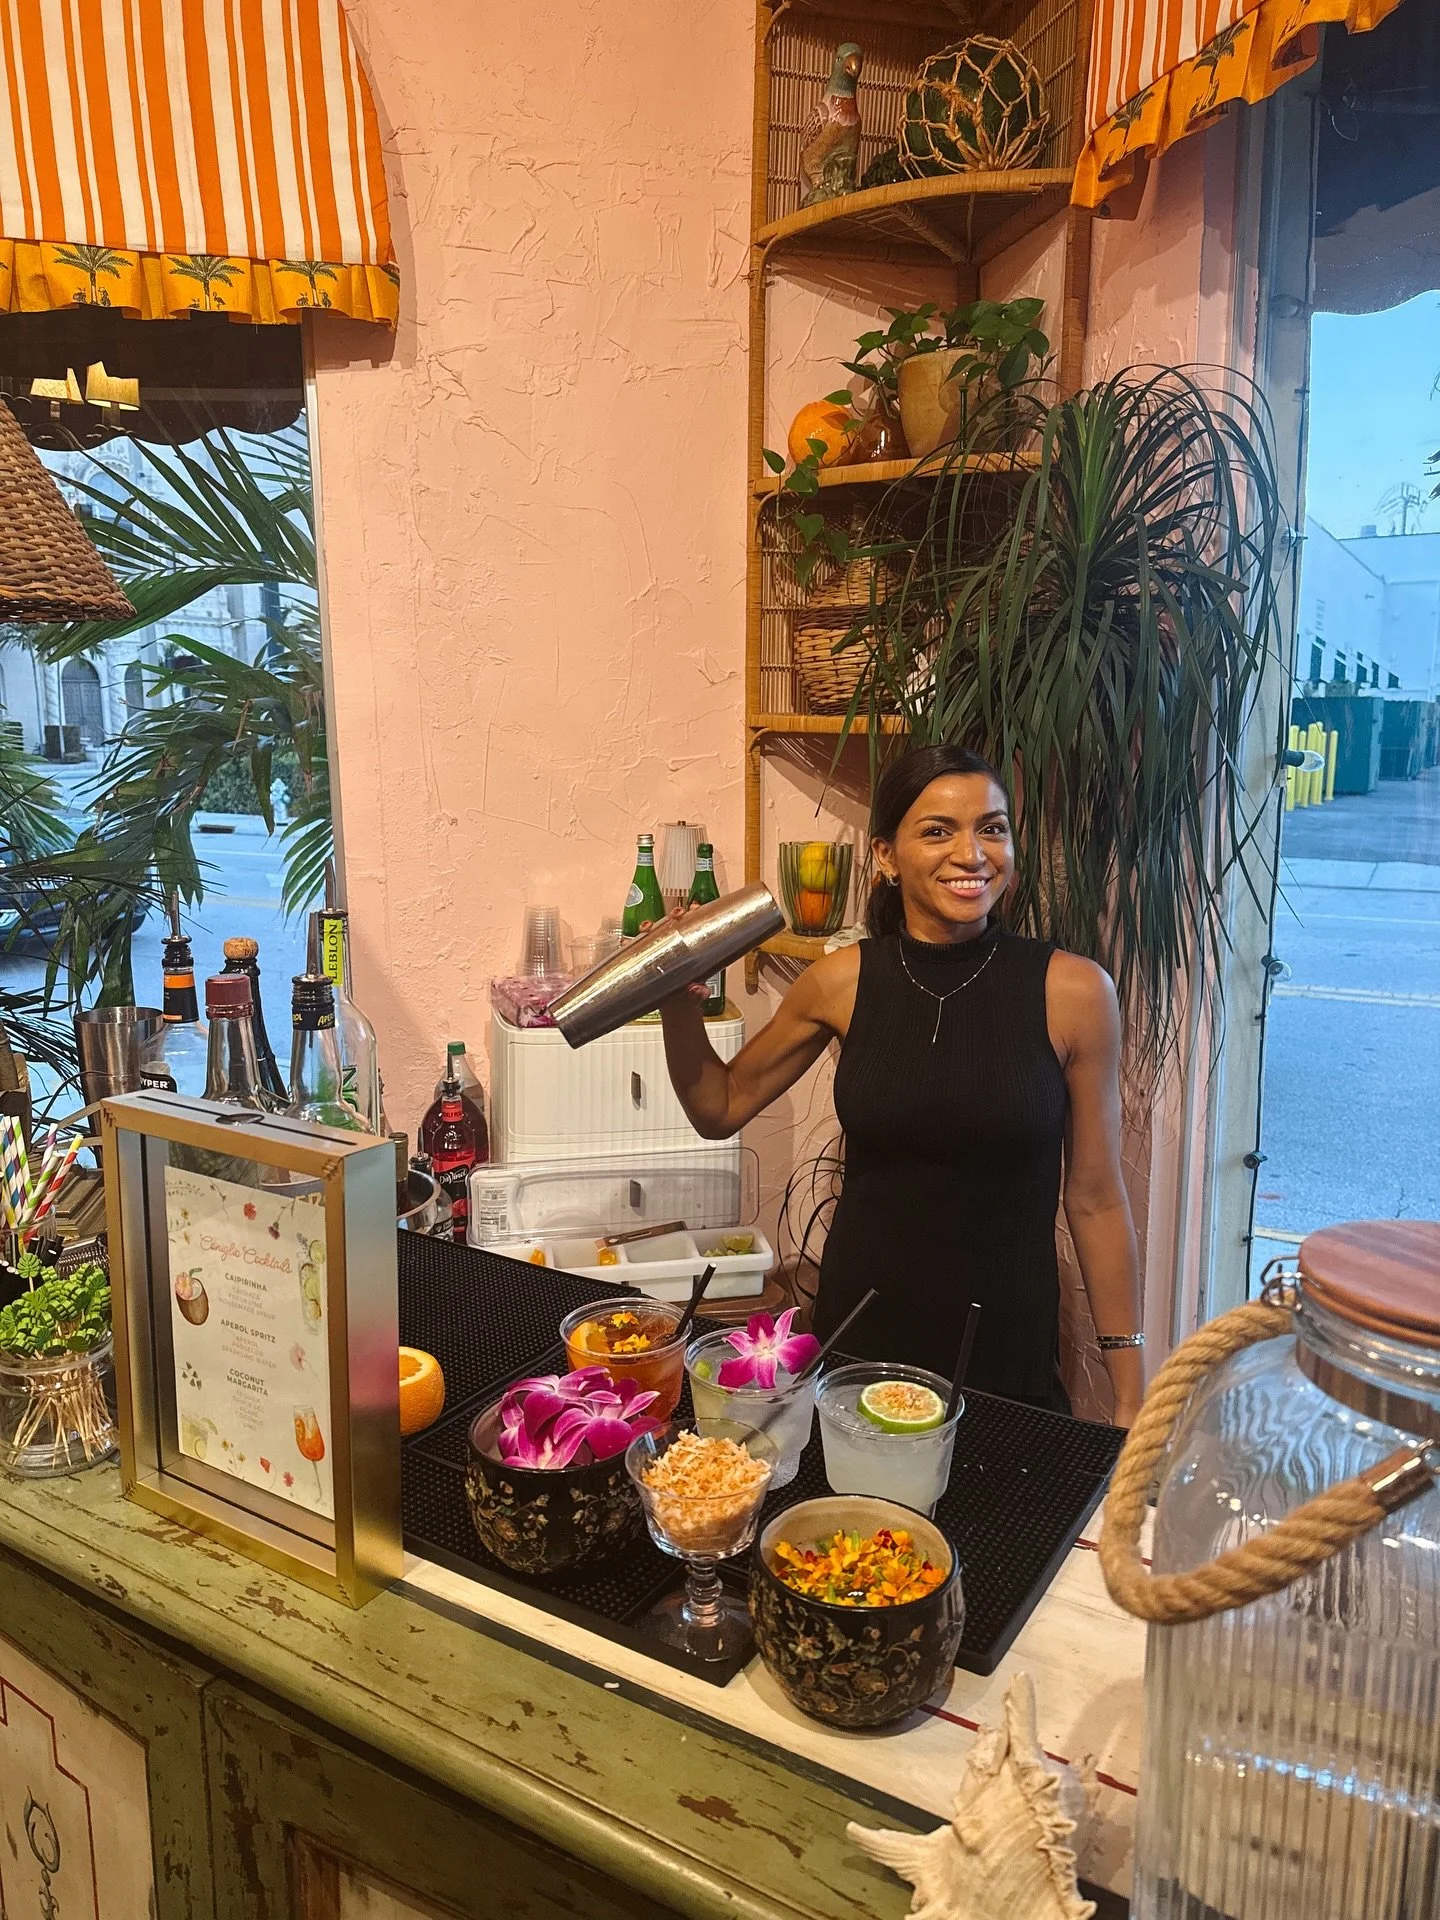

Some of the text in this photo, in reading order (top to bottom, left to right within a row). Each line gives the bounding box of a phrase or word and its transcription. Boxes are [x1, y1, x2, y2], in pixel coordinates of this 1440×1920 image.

[328, 924, 338, 980] LEBLON
[200, 1233, 292, 1274] Coniglio Cocktails
[224, 1272, 267, 1292] CAIPIRINHA
[220, 1319, 276, 1344] APEROL SPRITZ
[226, 1375, 268, 1397] MARGARITA
[229, 1368, 265, 1386] COCONUT
